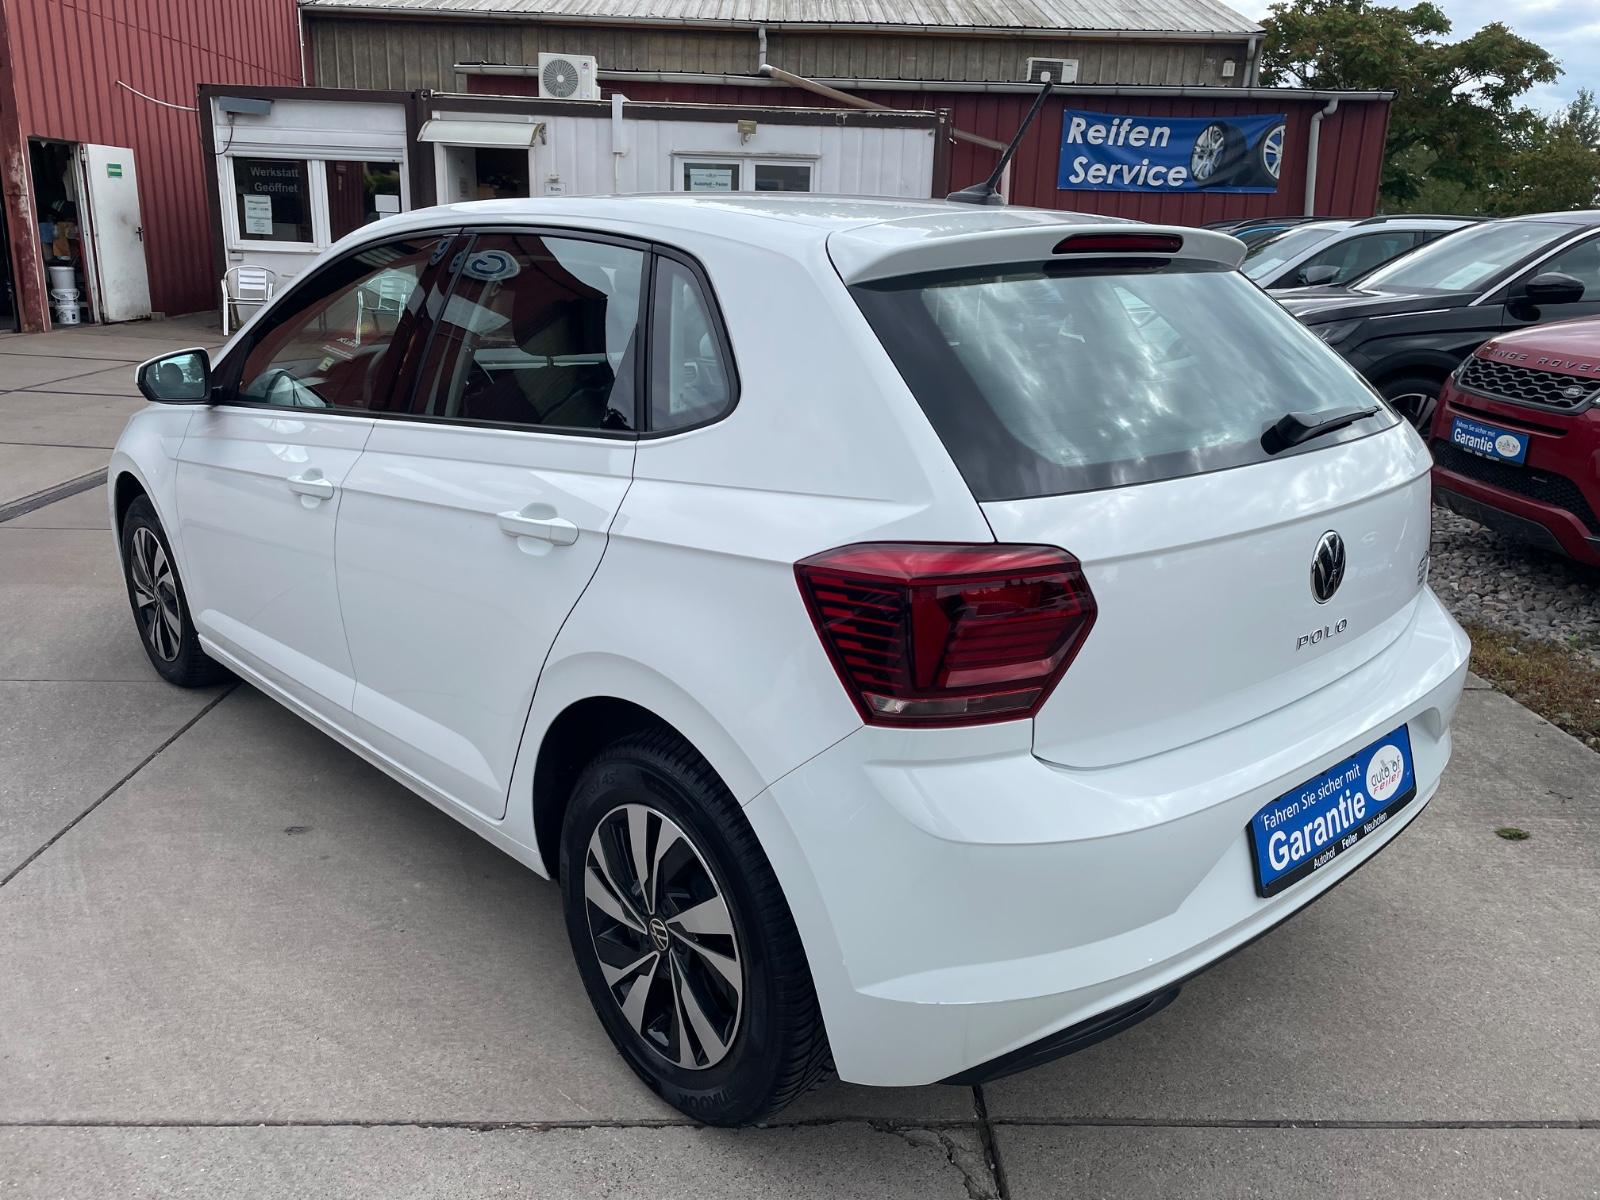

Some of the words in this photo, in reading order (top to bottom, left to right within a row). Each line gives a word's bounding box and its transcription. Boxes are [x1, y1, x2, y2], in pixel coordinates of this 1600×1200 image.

[1066, 116, 1171, 148] Reifen
[249, 166, 299, 178] Werkstatt
[254, 181, 298, 193] Geöffnet
[1068, 155, 1189, 187] Service
[1454, 428, 1493, 453] Garantie
[1295, 617, 1348, 652] POLO
[1263, 802, 1299, 830] Fahren
[1301, 792, 1316, 810] Sie
[1318, 775, 1343, 800] sicher
[1345, 763, 1360, 783] mit
[1268, 789, 1366, 871] Garantie
[1312, 846, 1336, 869] Autohof
